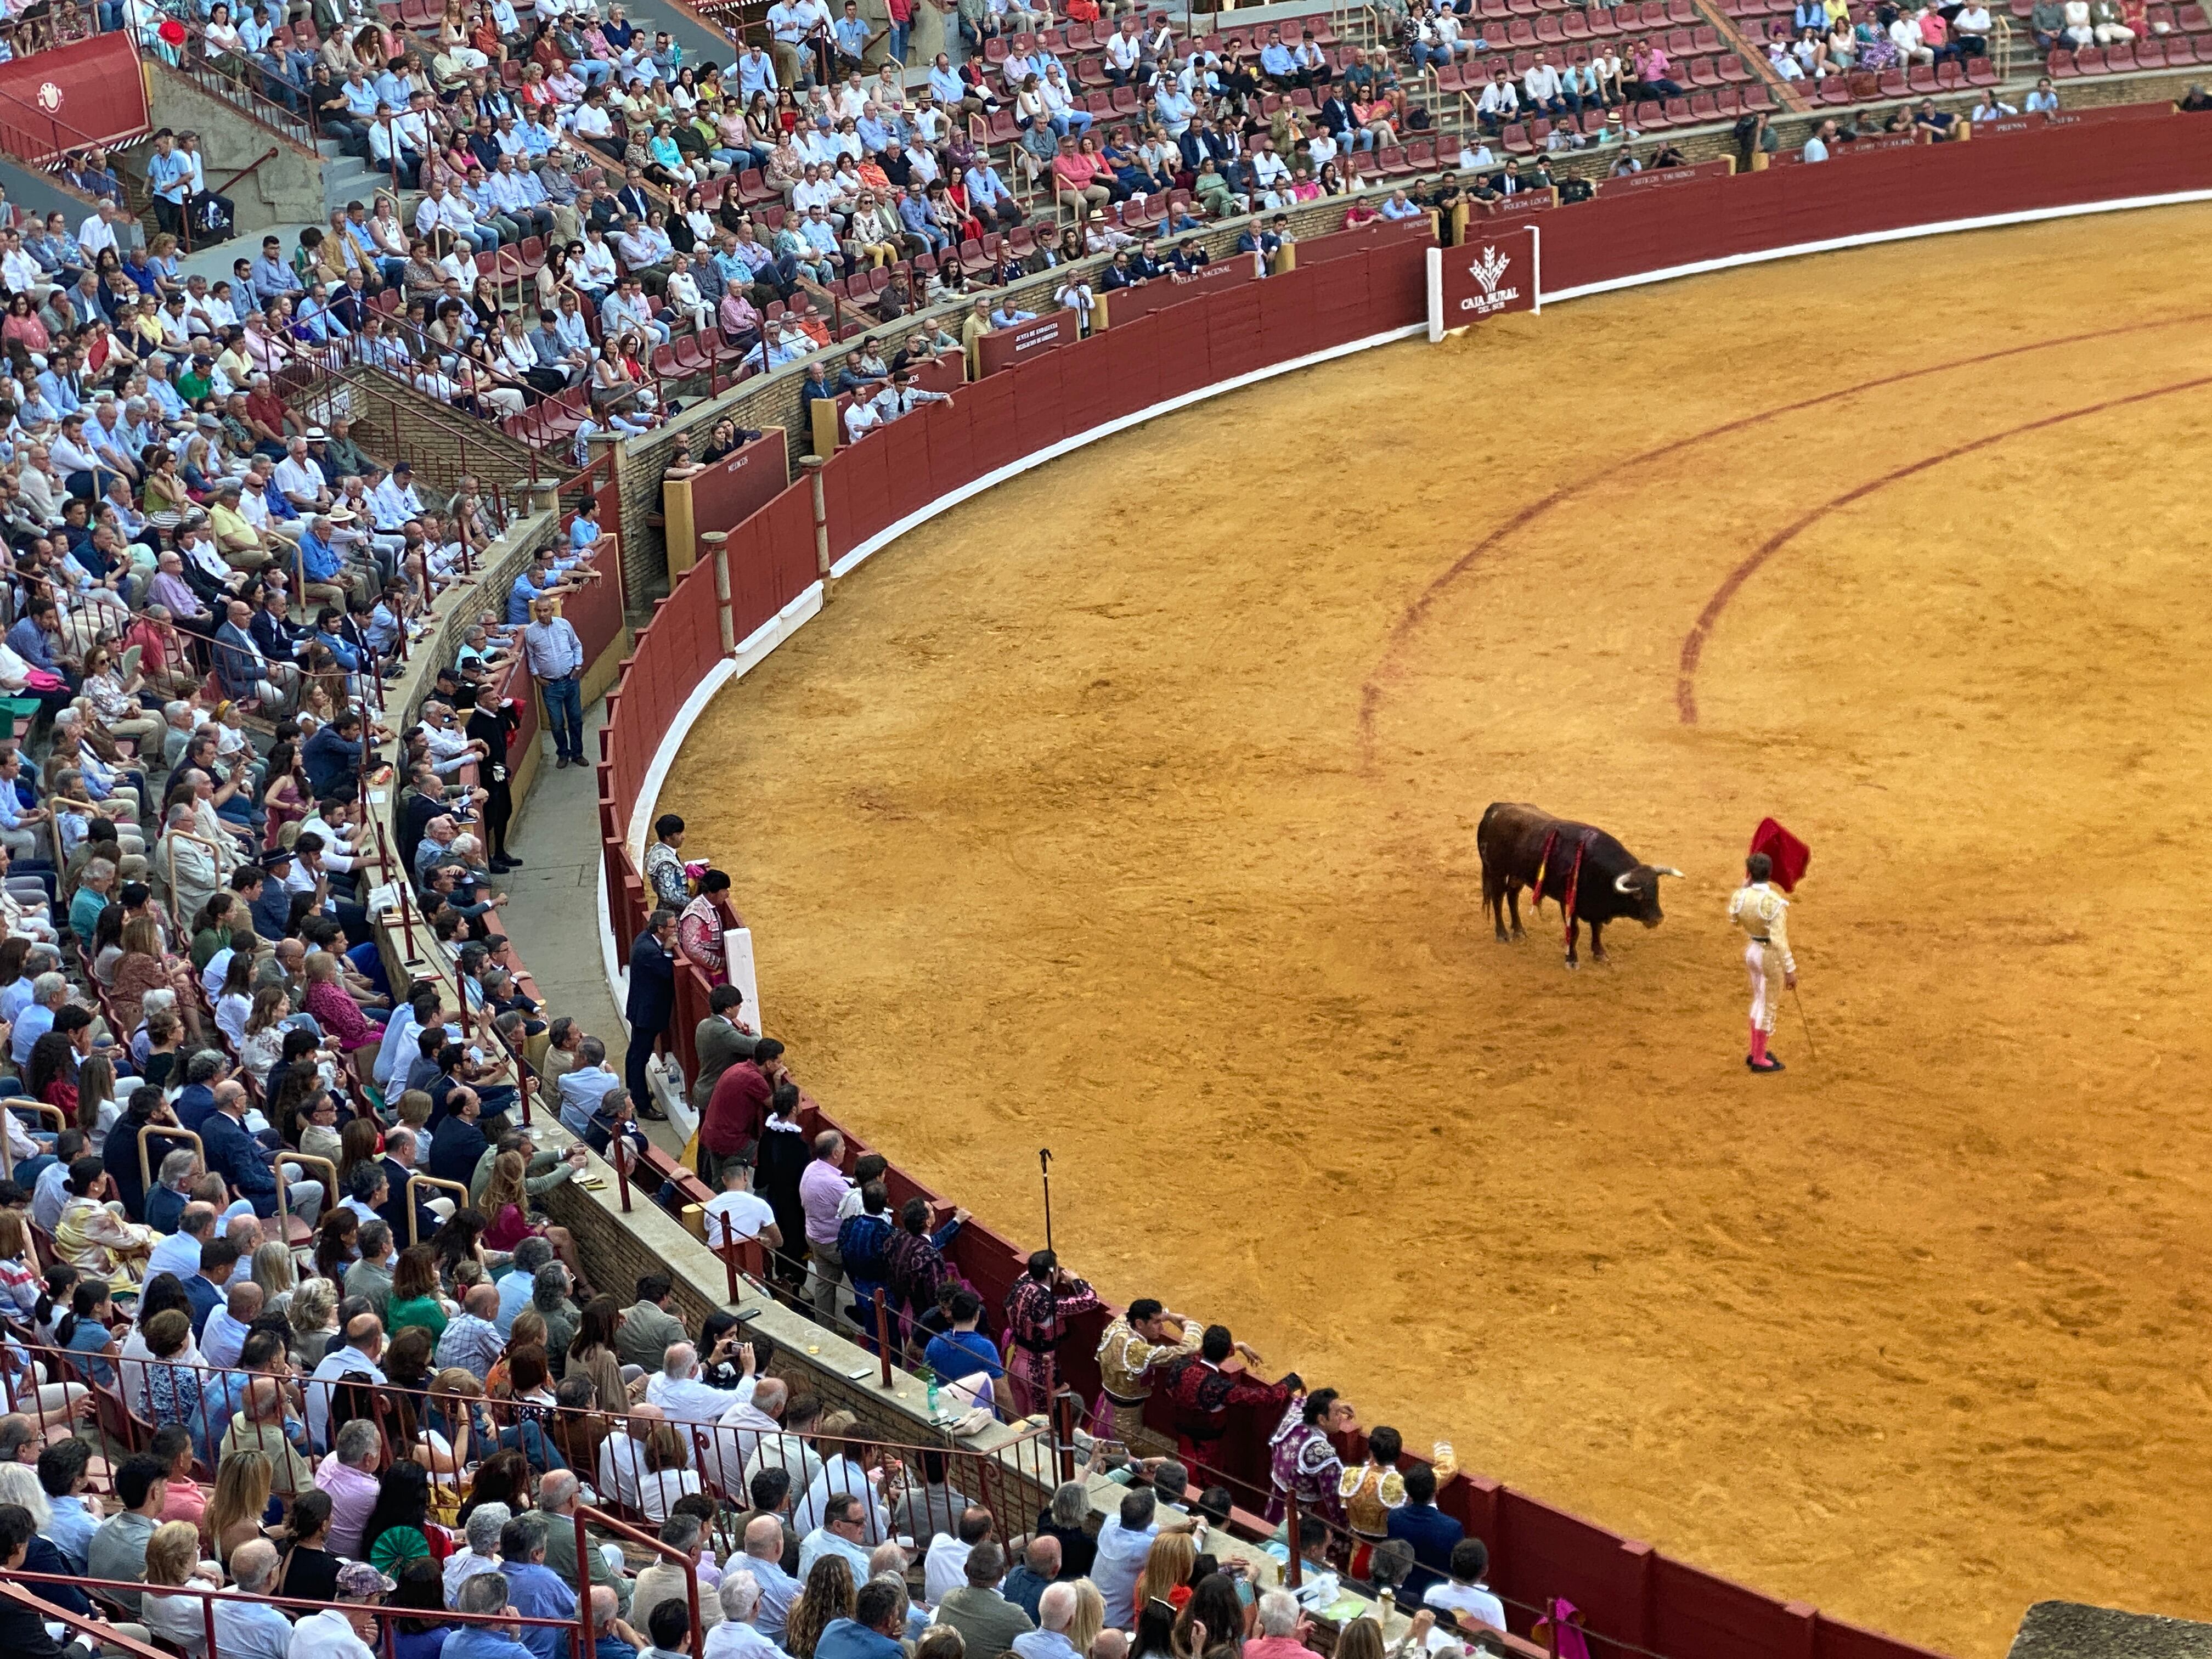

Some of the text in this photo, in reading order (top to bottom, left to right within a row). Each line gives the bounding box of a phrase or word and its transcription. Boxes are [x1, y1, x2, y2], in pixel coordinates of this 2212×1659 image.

[1530, 196, 1551, 206] LOCAL
[1203, 264, 1232, 279] NACIONAL
[1486, 286, 1519, 304] RURAL
